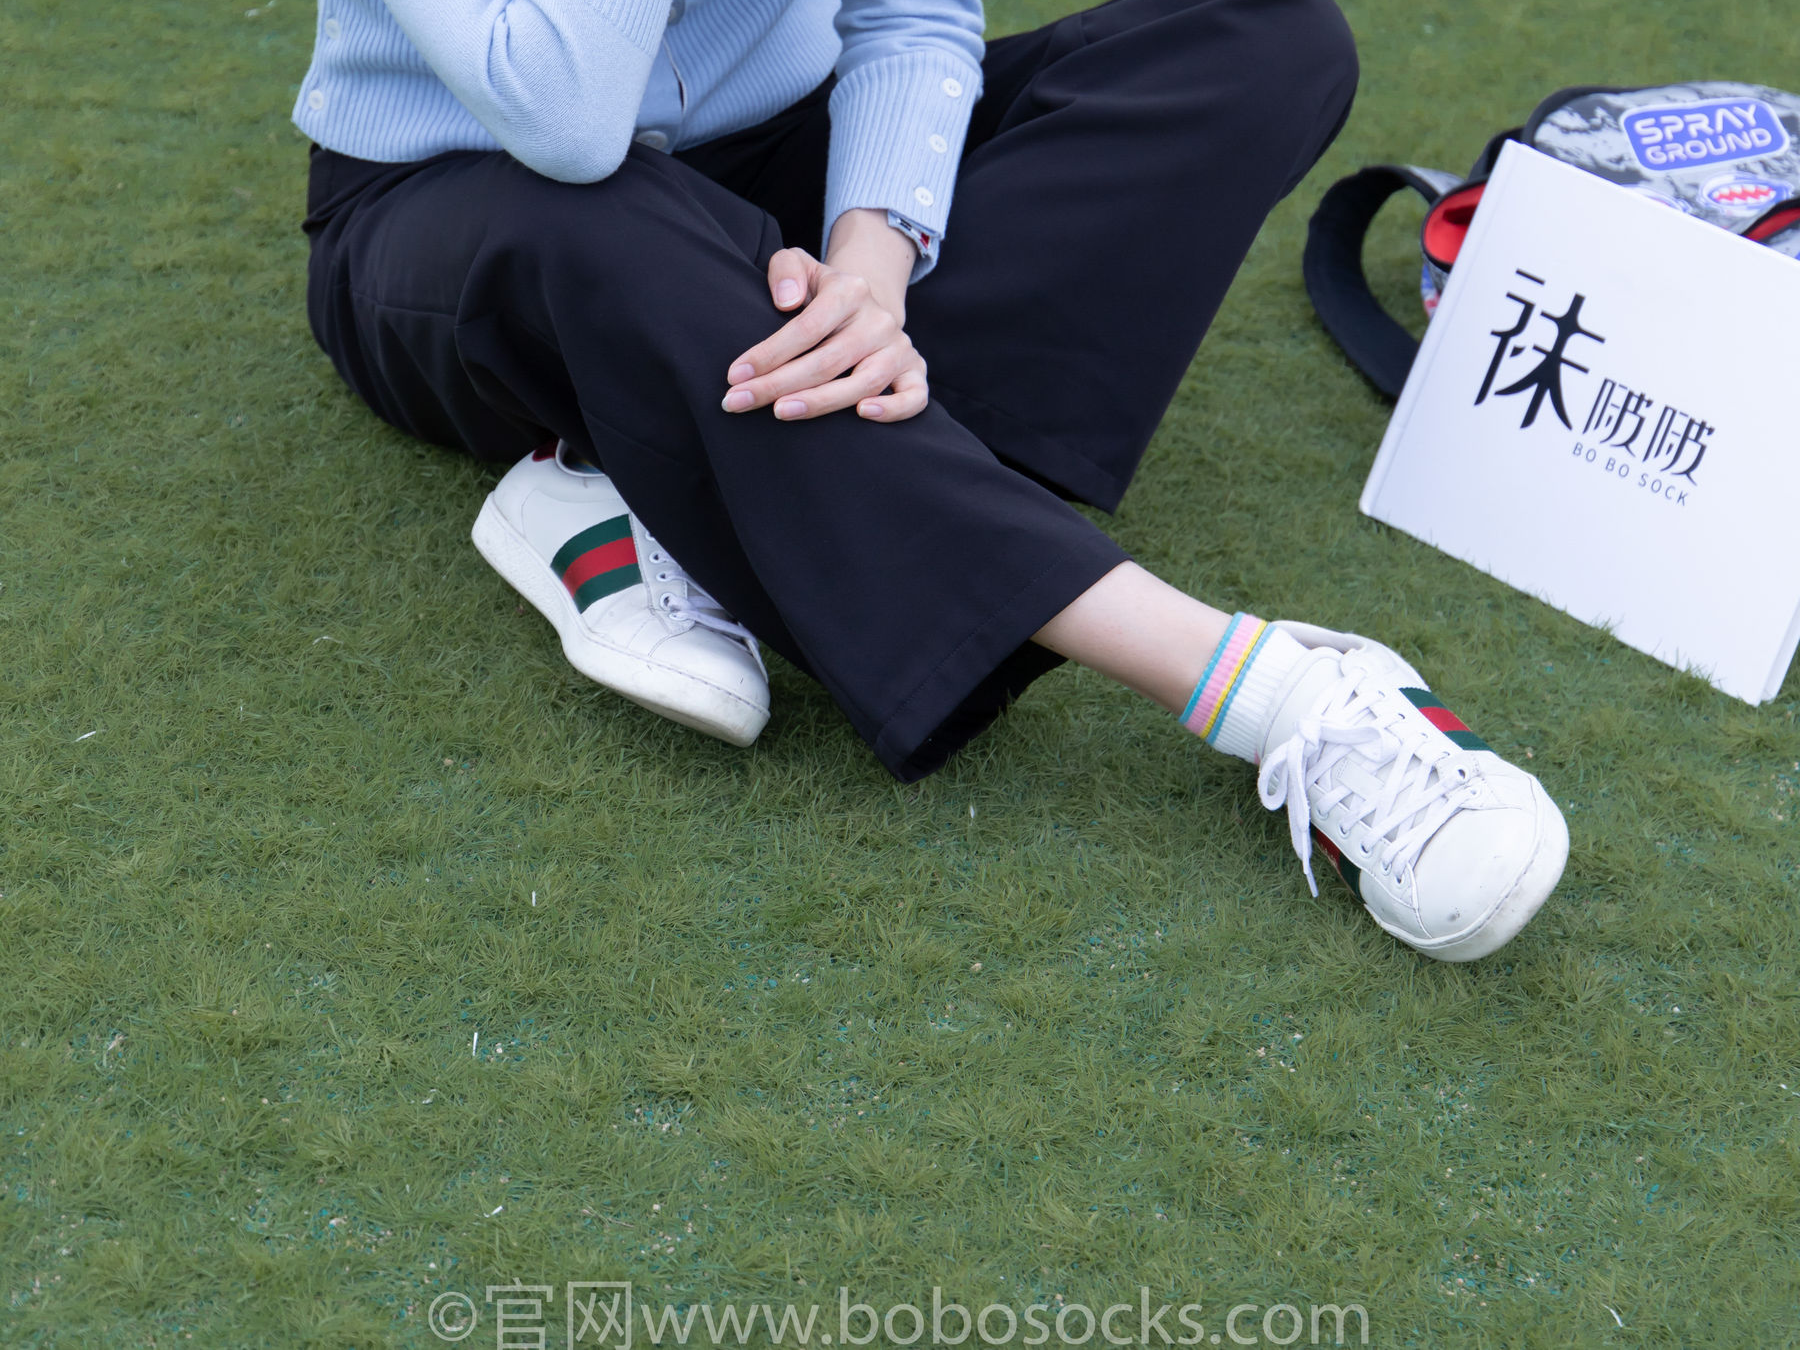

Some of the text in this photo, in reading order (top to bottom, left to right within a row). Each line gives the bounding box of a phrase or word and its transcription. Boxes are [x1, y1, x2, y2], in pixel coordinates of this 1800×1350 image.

[1634, 104, 1758, 145] SPRAY
[1645, 127, 1773, 165] GROUND
[1572, 442, 1689, 507] BO BO SOCK
